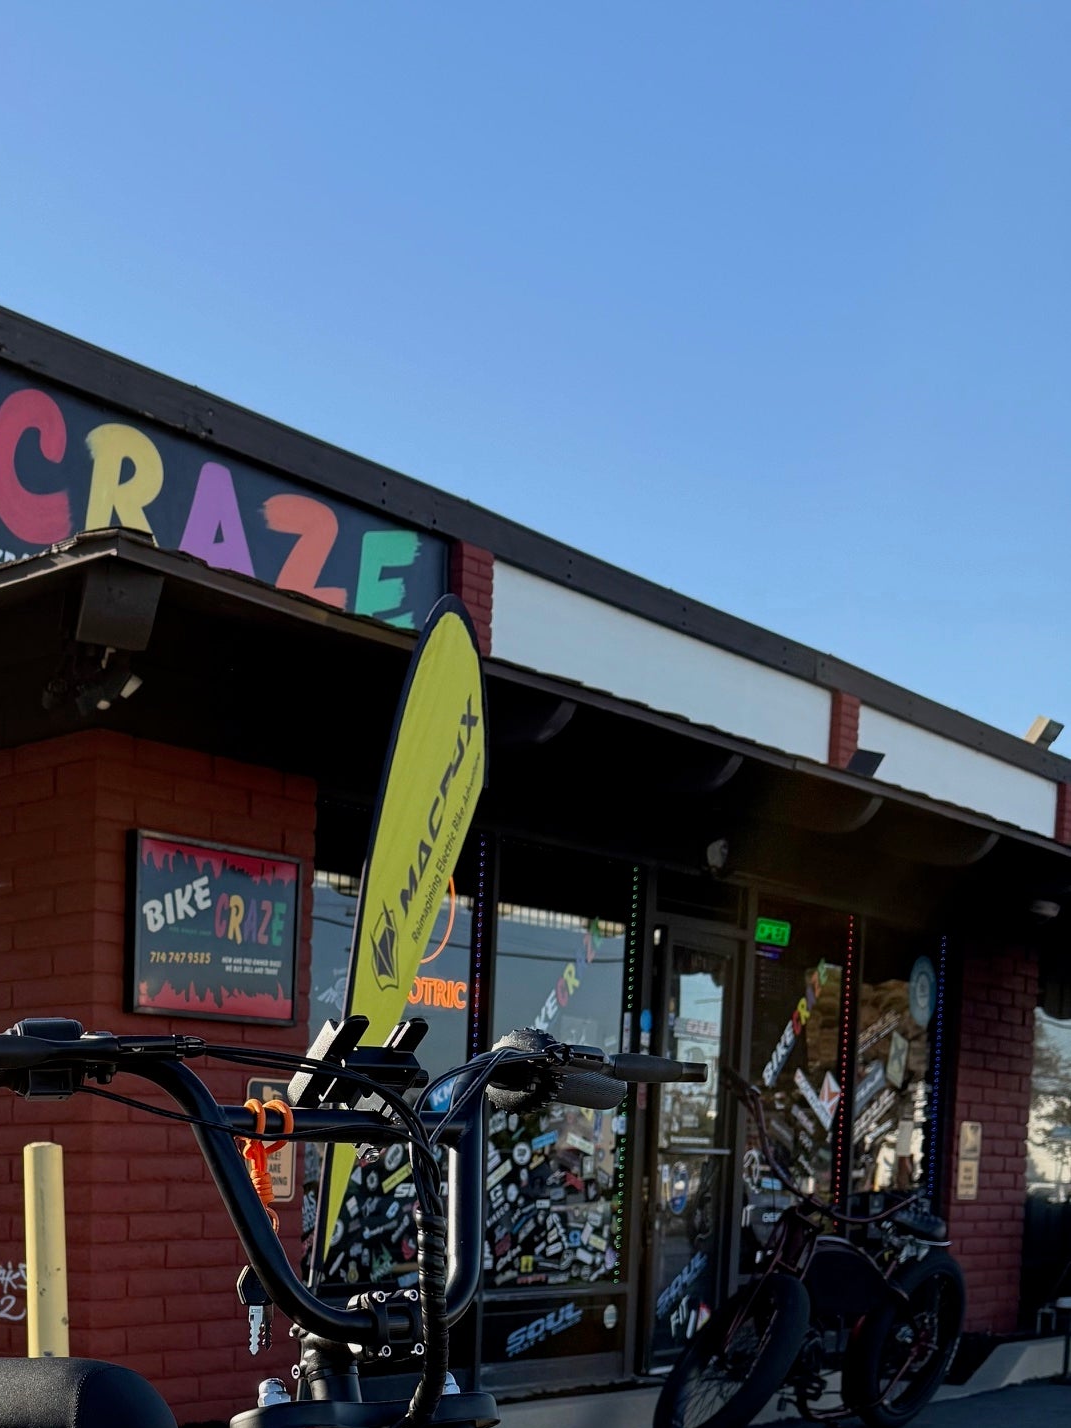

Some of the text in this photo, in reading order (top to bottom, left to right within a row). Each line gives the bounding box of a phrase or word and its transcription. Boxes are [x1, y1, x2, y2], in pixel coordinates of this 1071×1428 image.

[142, 875, 287, 947] BIKE CRAZE
[411, 873, 444, 945] Reimagining
[435, 831, 457, 874] Electric
[451, 806, 465, 832] Bike
[150, 950, 167, 964] 714
[168, 951, 187, 964] 747
